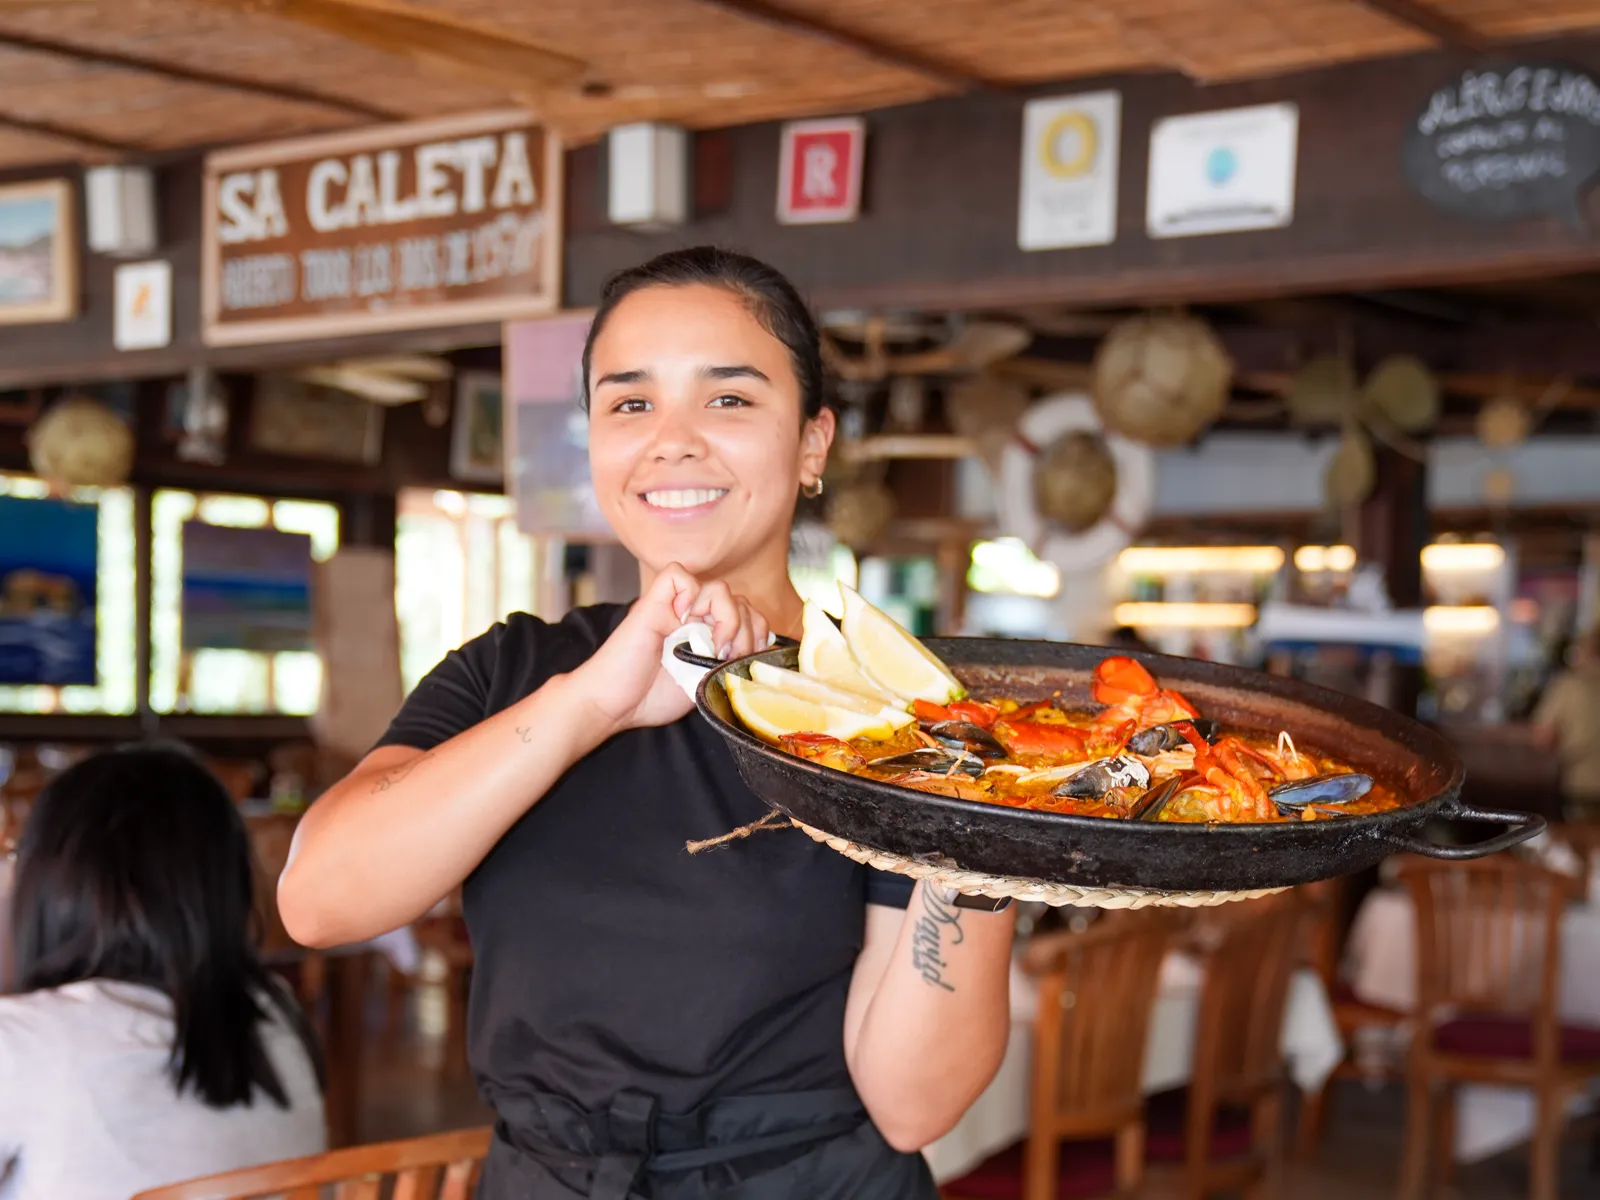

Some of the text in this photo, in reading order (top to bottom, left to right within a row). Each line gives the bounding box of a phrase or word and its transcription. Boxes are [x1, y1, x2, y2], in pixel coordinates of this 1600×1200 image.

[218, 131, 536, 244] SA CALETA
[802, 142, 839, 199] R
